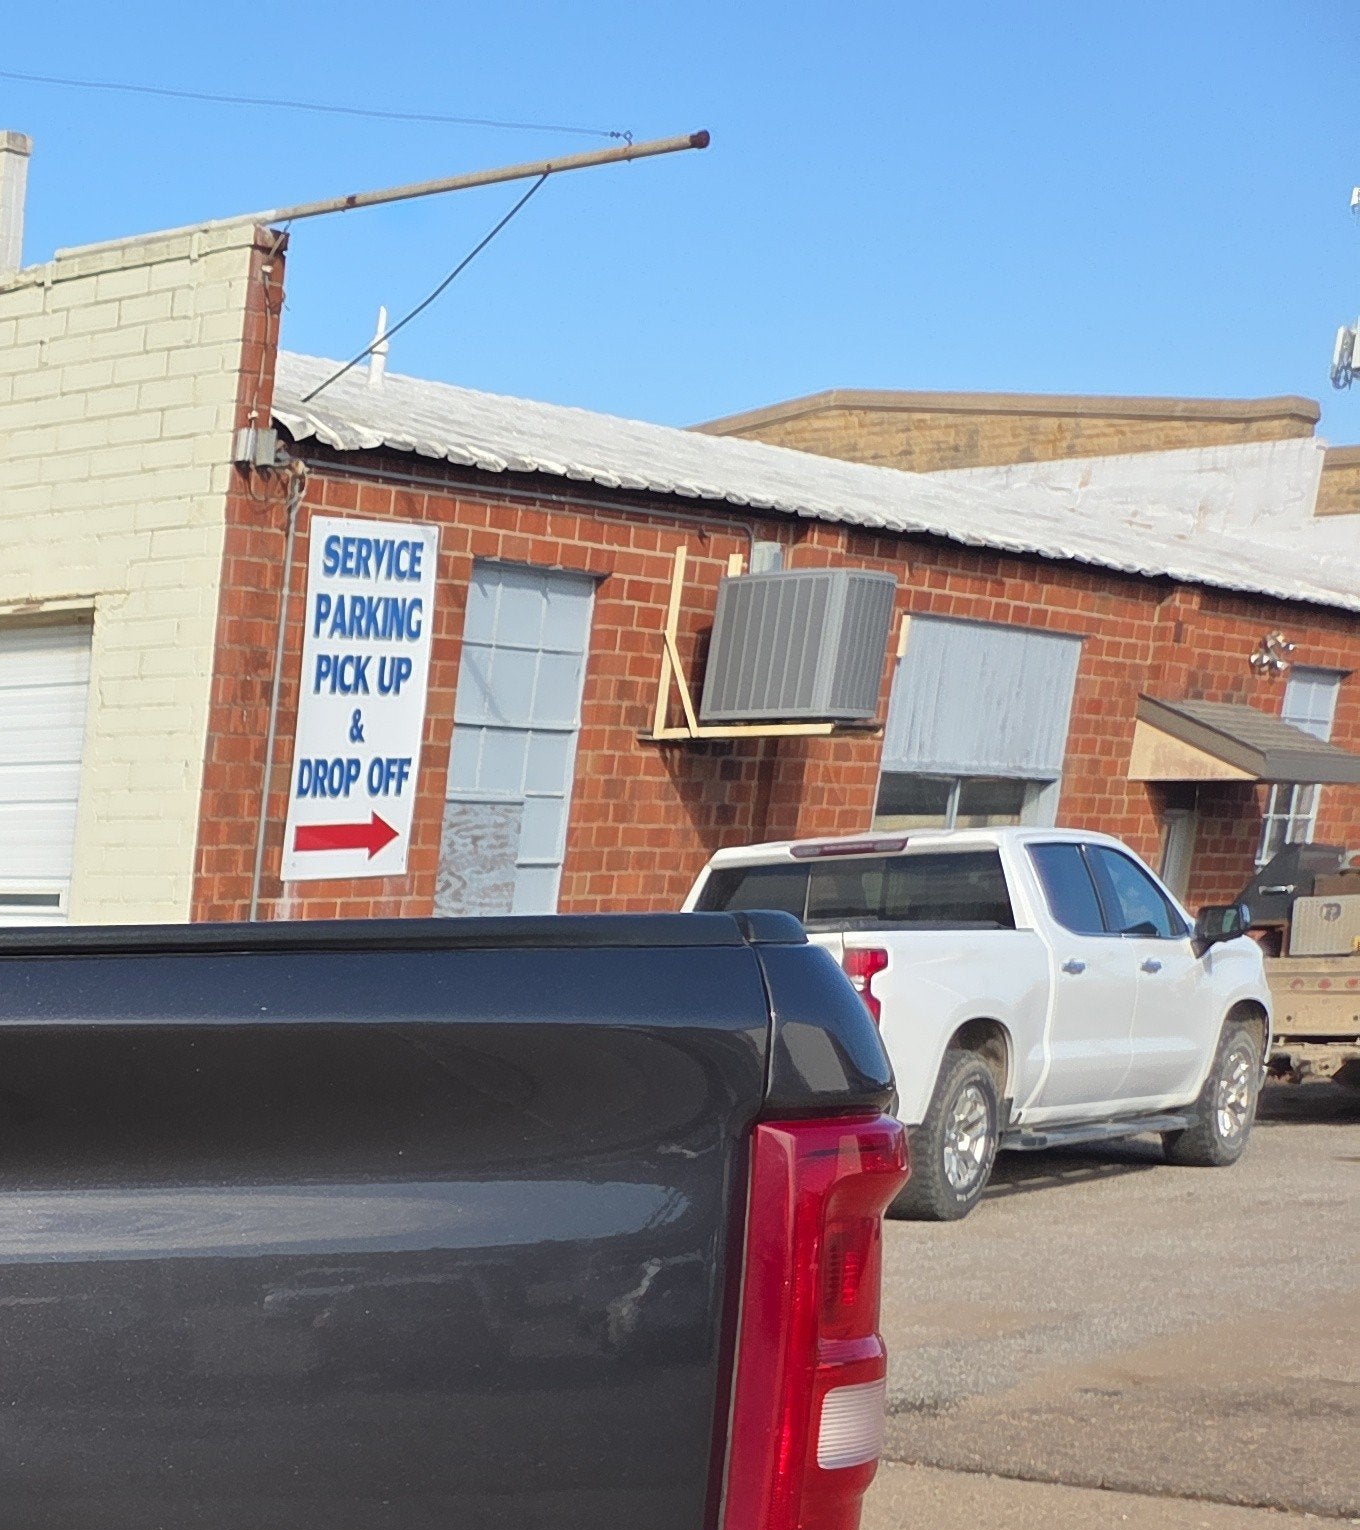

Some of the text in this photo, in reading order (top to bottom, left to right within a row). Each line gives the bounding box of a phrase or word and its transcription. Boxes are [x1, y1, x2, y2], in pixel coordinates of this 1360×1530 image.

[322, 534, 425, 583] SERVICE
[313, 593, 423, 642] PARKING
[313, 654, 413, 695] PICK UP
[348, 708, 366, 744] &
[296, 757, 412, 798] DROP OFF
